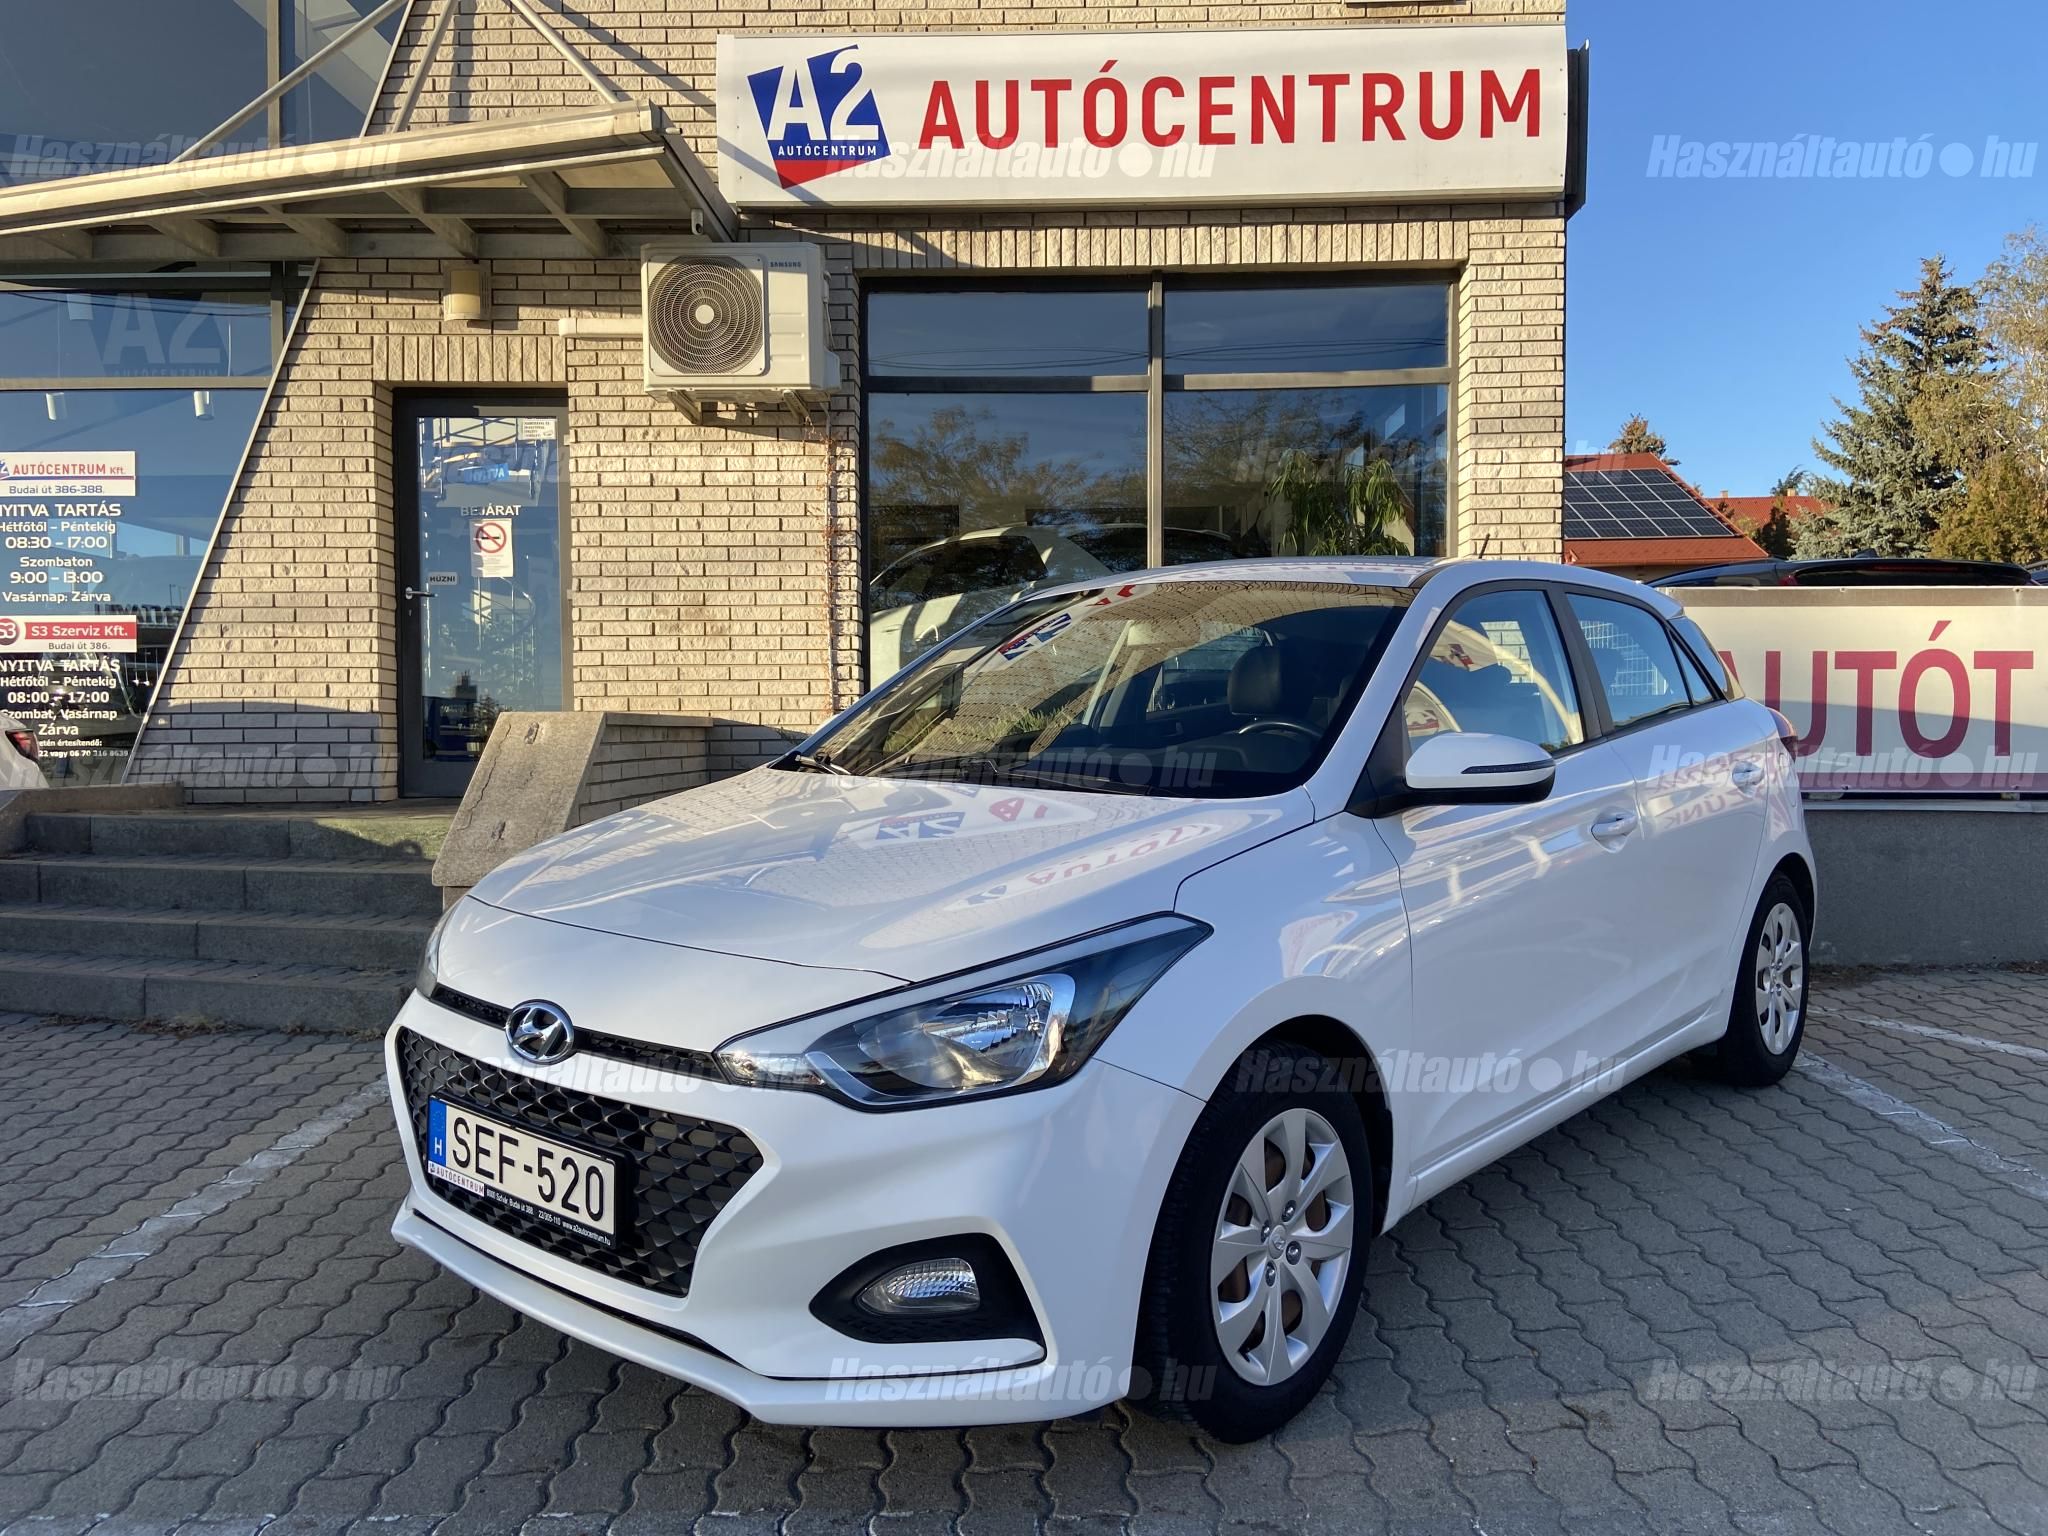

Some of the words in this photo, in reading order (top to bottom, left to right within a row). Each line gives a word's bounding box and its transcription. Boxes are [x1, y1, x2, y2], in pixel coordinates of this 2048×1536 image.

[767, 46, 879, 140] A2
[919, 60, 1542, 150] AUTÓCENTRUM
[778, 143, 877, 156] AUTÓCENTRUM
[13, 461, 106, 475] AUTÓCENTRUM
[9, 485, 38, 494] Budai
[41, 485, 52, 494] út
[54, 500, 122, 517] TARTÁS
[61, 521, 116, 534] Péntekig
[5, 536, 51, 549] 08:30
[67, 536, 108, 549] 17:00
[20, 556, 93, 568] Szombaton
[10, 571, 48, 584] 9:00
[2, 591, 68, 604] Vasárnap:
[71, 590, 111, 603] Zárva
[31, 626, 48, 637] S3
[52, 625, 100, 637] Szerviz
[104, 625, 128, 637] Kft.
[49, 642, 75, 650] Budai
[77, 641, 87, 650] út
[90, 642, 111, 650] 386.
[62, 655, 121, 672] TARTÁS
[0, 675, 49, 687] Hétfőtől
[64, 675, 117, 689] Péntekig
[1719, 619, 2034, 759] UTÓT
[7, 691, 49, 704] 08:00
[68, 691, 110, 703] 17:00
[60, 708, 118, 721] Vasárnap
[38, 723, 79, 736] Zárva
[434, 1137, 443, 1156] H
[452, 1116, 605, 1223] SEF-520
